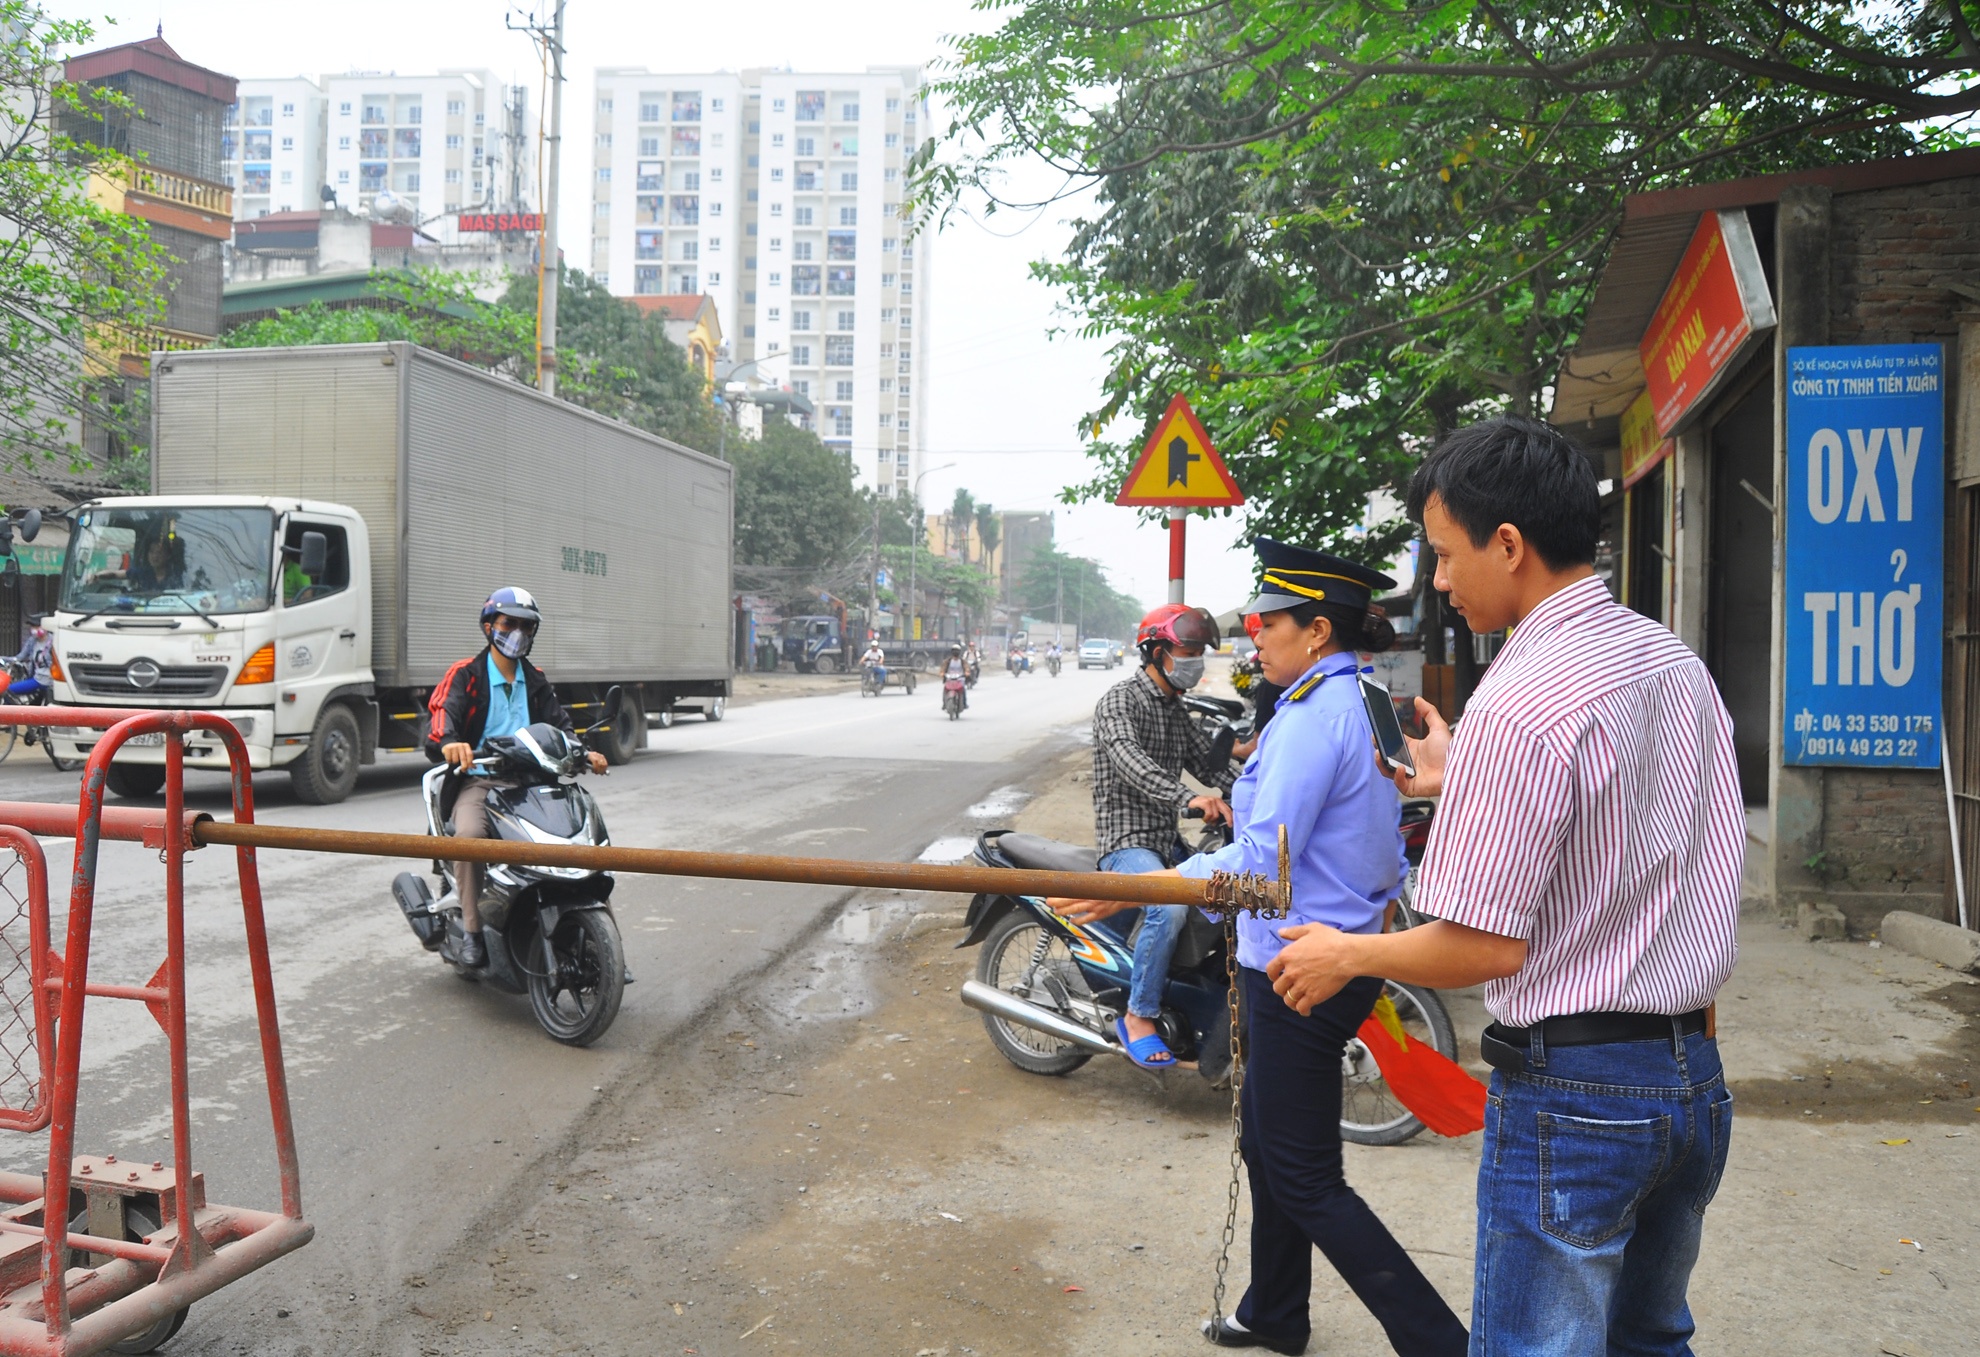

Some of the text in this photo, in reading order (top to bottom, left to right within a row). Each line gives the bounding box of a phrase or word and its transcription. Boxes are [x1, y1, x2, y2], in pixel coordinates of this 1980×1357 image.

[459, 213, 544, 231] MASSAGE
[1806, 357, 1817, 371] KẾ
[1818, 360, 1849, 372] HOẠCH
[1921, 354, 1938, 368] NỘI
[1792, 370, 1938, 396] CÔNG TY TNHH TIẾN XUÂN
[1807, 427, 1924, 525] OXY
[1803, 548, 1922, 687] THỞ
[196, 655, 231, 663] 500
[1822, 714, 1842, 732] 04
[1845, 714, 1866, 732] 33
[1869, 715, 1899, 733] 530
[1904, 715, 1933, 733] 175
[1807, 737, 1846, 755] 0914
[1850, 738, 1870, 756] 49
[1873, 739, 1894, 756] 23
